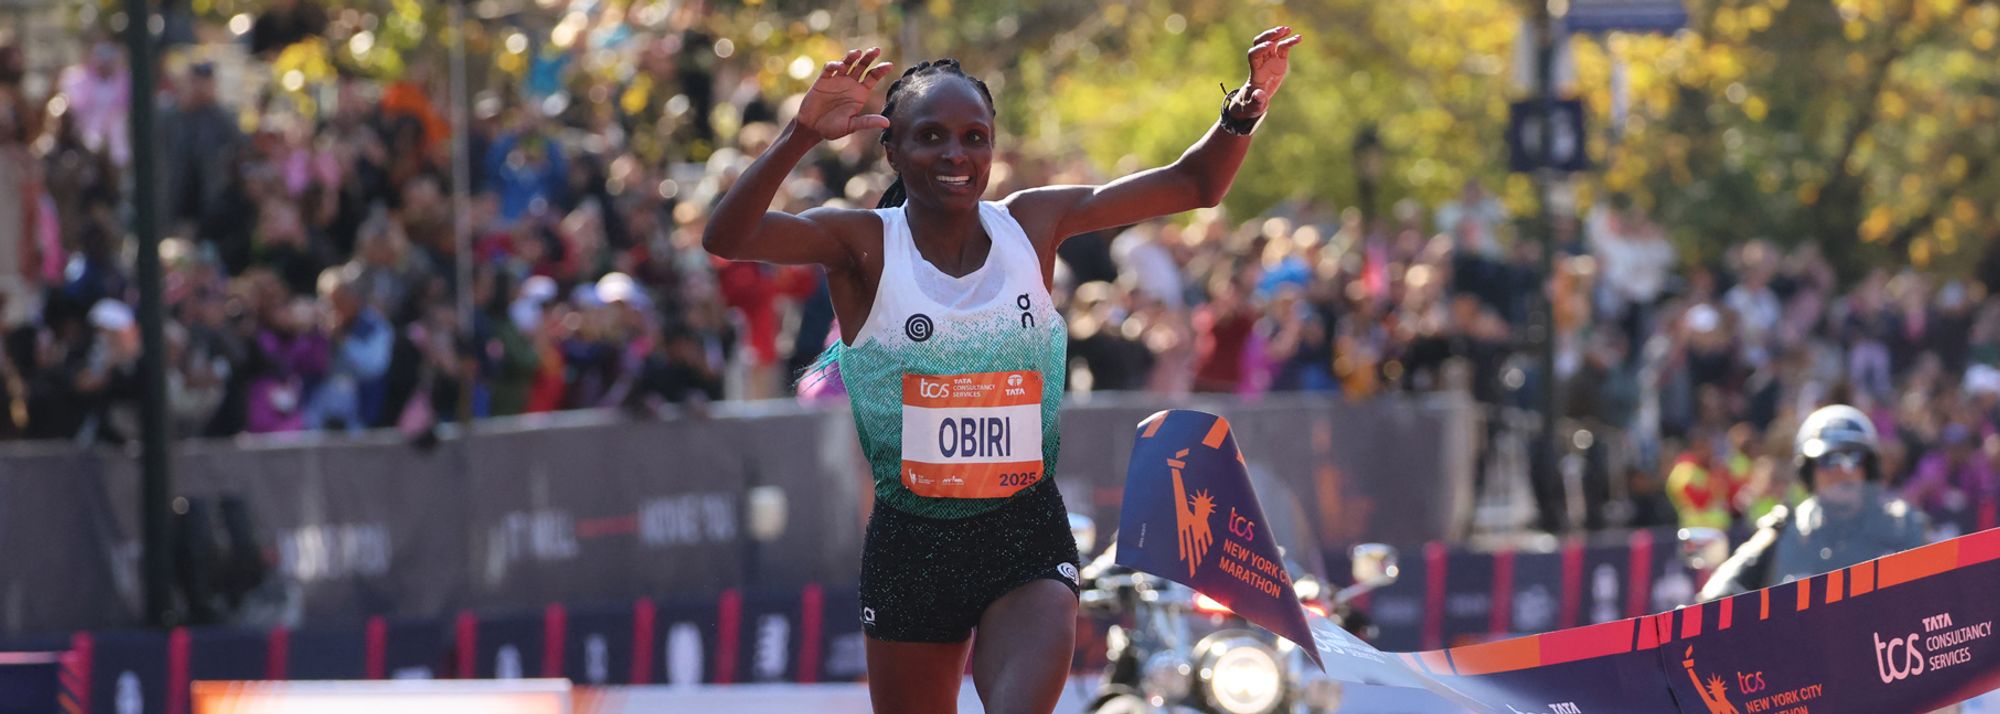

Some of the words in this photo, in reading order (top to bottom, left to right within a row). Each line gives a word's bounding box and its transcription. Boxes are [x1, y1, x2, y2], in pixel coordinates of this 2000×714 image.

[920, 378, 949, 398] tcs
[1005, 388, 1025, 396] TATA
[938, 416, 1011, 458] OBIRI
[999, 472, 1036, 487] 2025
[1229, 506, 1255, 541] tcs
[1223, 538, 1250, 562] NEW
[1251, 553, 1279, 579] YORK
[1219, 556, 1281, 598] MARATHON
[1922, 612, 1953, 632] TATA
[1926, 621, 1992, 652] CONSULTANCY
[1873, 632, 1925, 684] tcs
[1929, 647, 1972, 671] SERVICES
[1737, 671, 1766, 695] tcs
[1548, 701, 1582, 714] TATA
[1745, 697, 1770, 714] NEW
[1771, 690, 1800, 708] YORK
[1800, 684, 1823, 700] CITY
